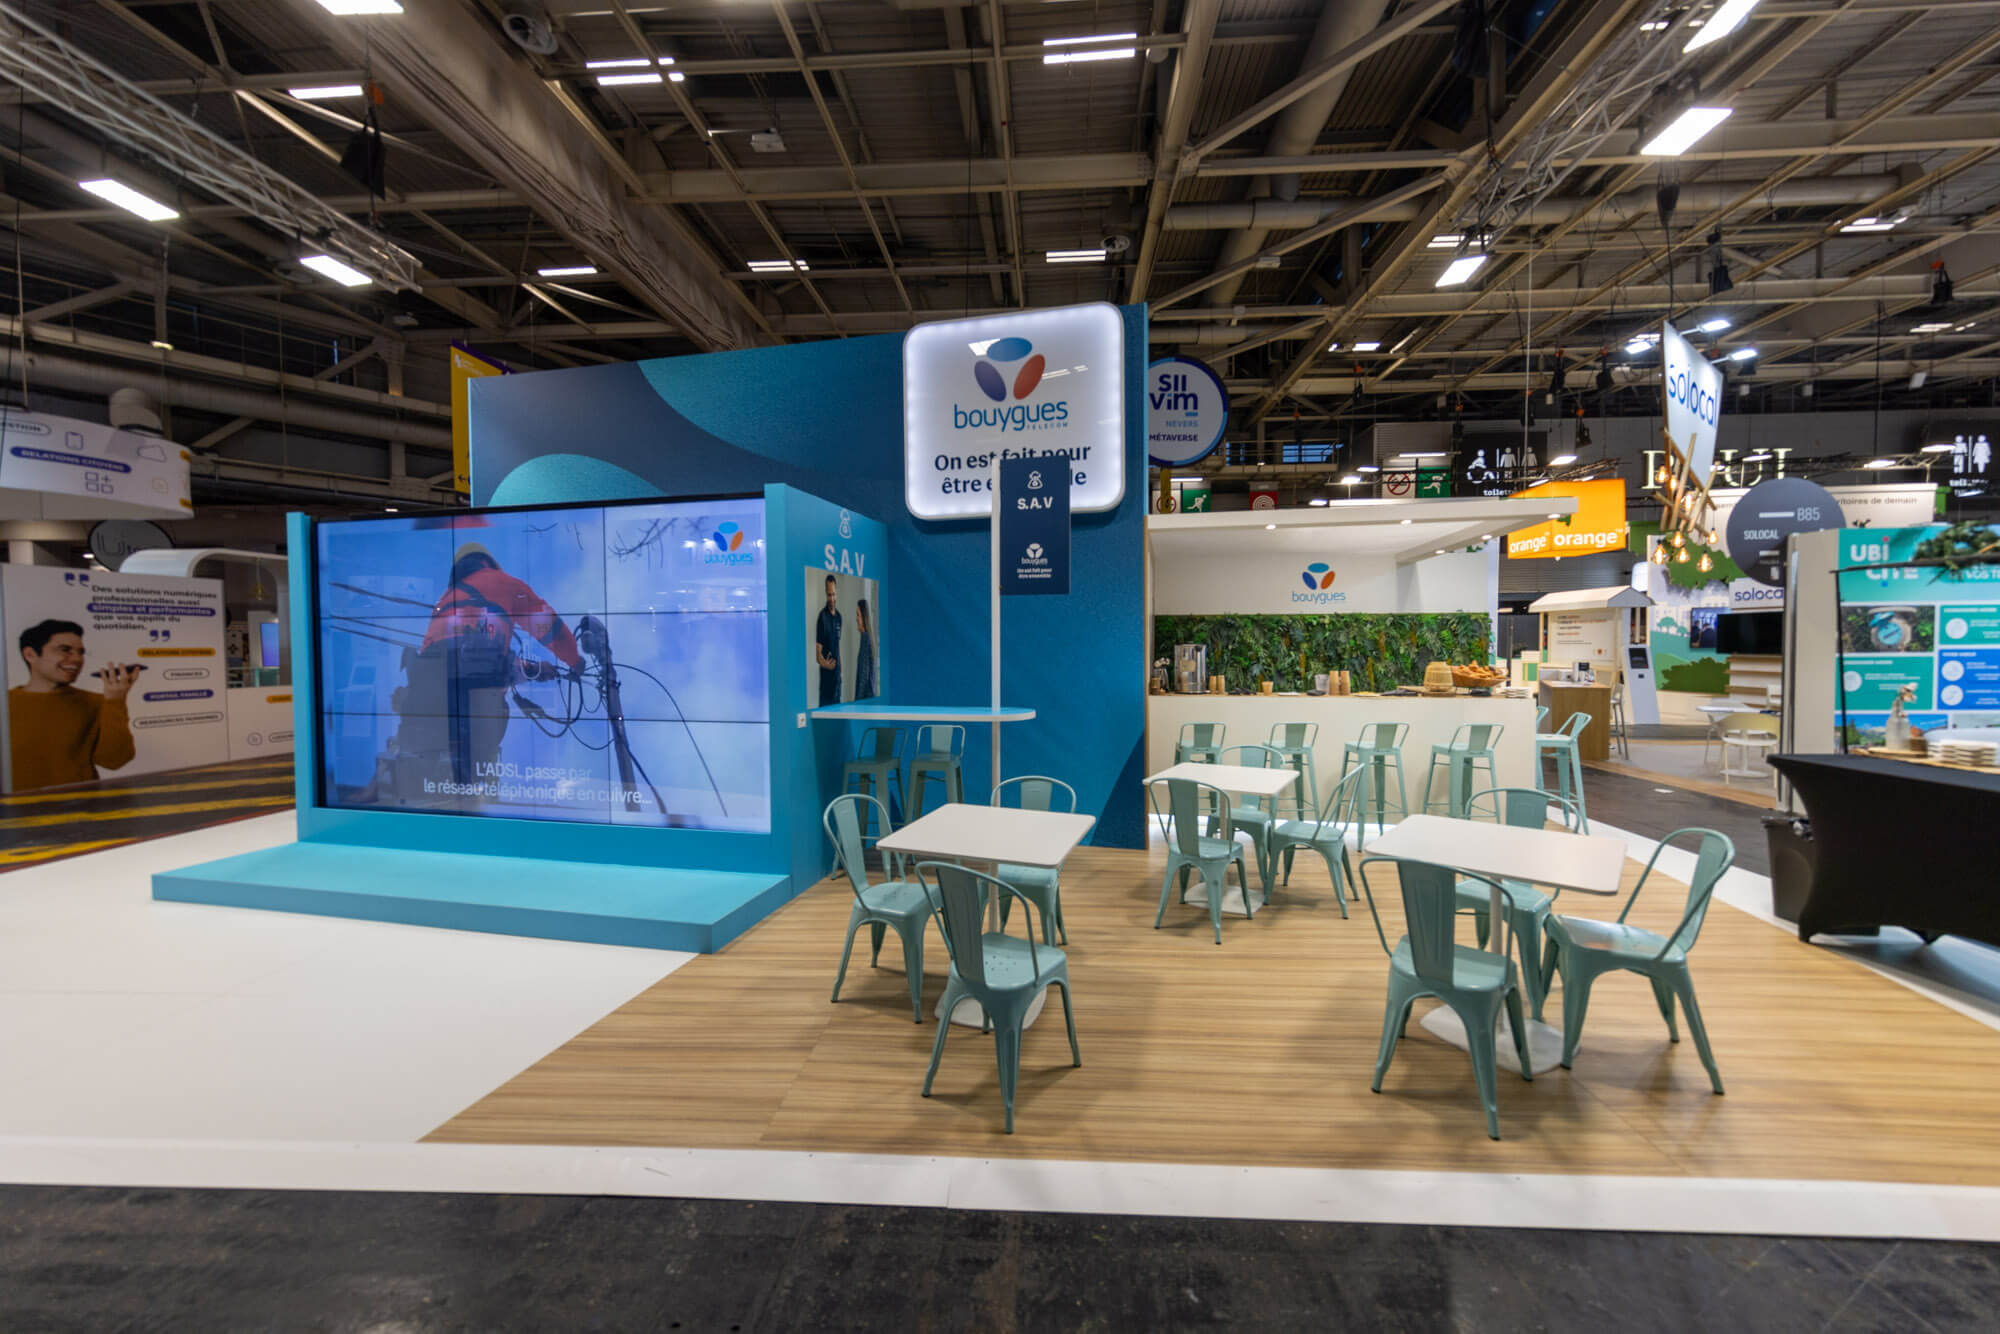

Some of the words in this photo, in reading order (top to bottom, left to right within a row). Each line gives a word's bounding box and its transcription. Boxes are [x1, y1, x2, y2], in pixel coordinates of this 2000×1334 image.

[953, 401, 1069, 432] bouygues
[1166, 420, 1198, 428] NEVERS
[1149, 432, 1199, 442] MÉTAVERSE
[934, 454, 962, 471] On
[967, 451, 998, 468] est
[941, 477, 982, 494] être
[1871, 496, 1882, 505] de
[1797, 506, 1820, 521] B85
[1509, 536, 1547, 553] orange
[1553, 531, 1618, 547] orange
[1743, 528, 1780, 540] SOLOCAL
[1291, 591, 1346, 604] bouygues
[1734, 586, 1785, 602] soloca
[475, 762, 523, 779] L'ADSL
[525, 765, 567, 781] passe
[423, 777, 435, 793] le
[437, 779, 482, 795] réseau
[483, 782, 575, 801] téléphonique
[575, 789, 596, 801] en
